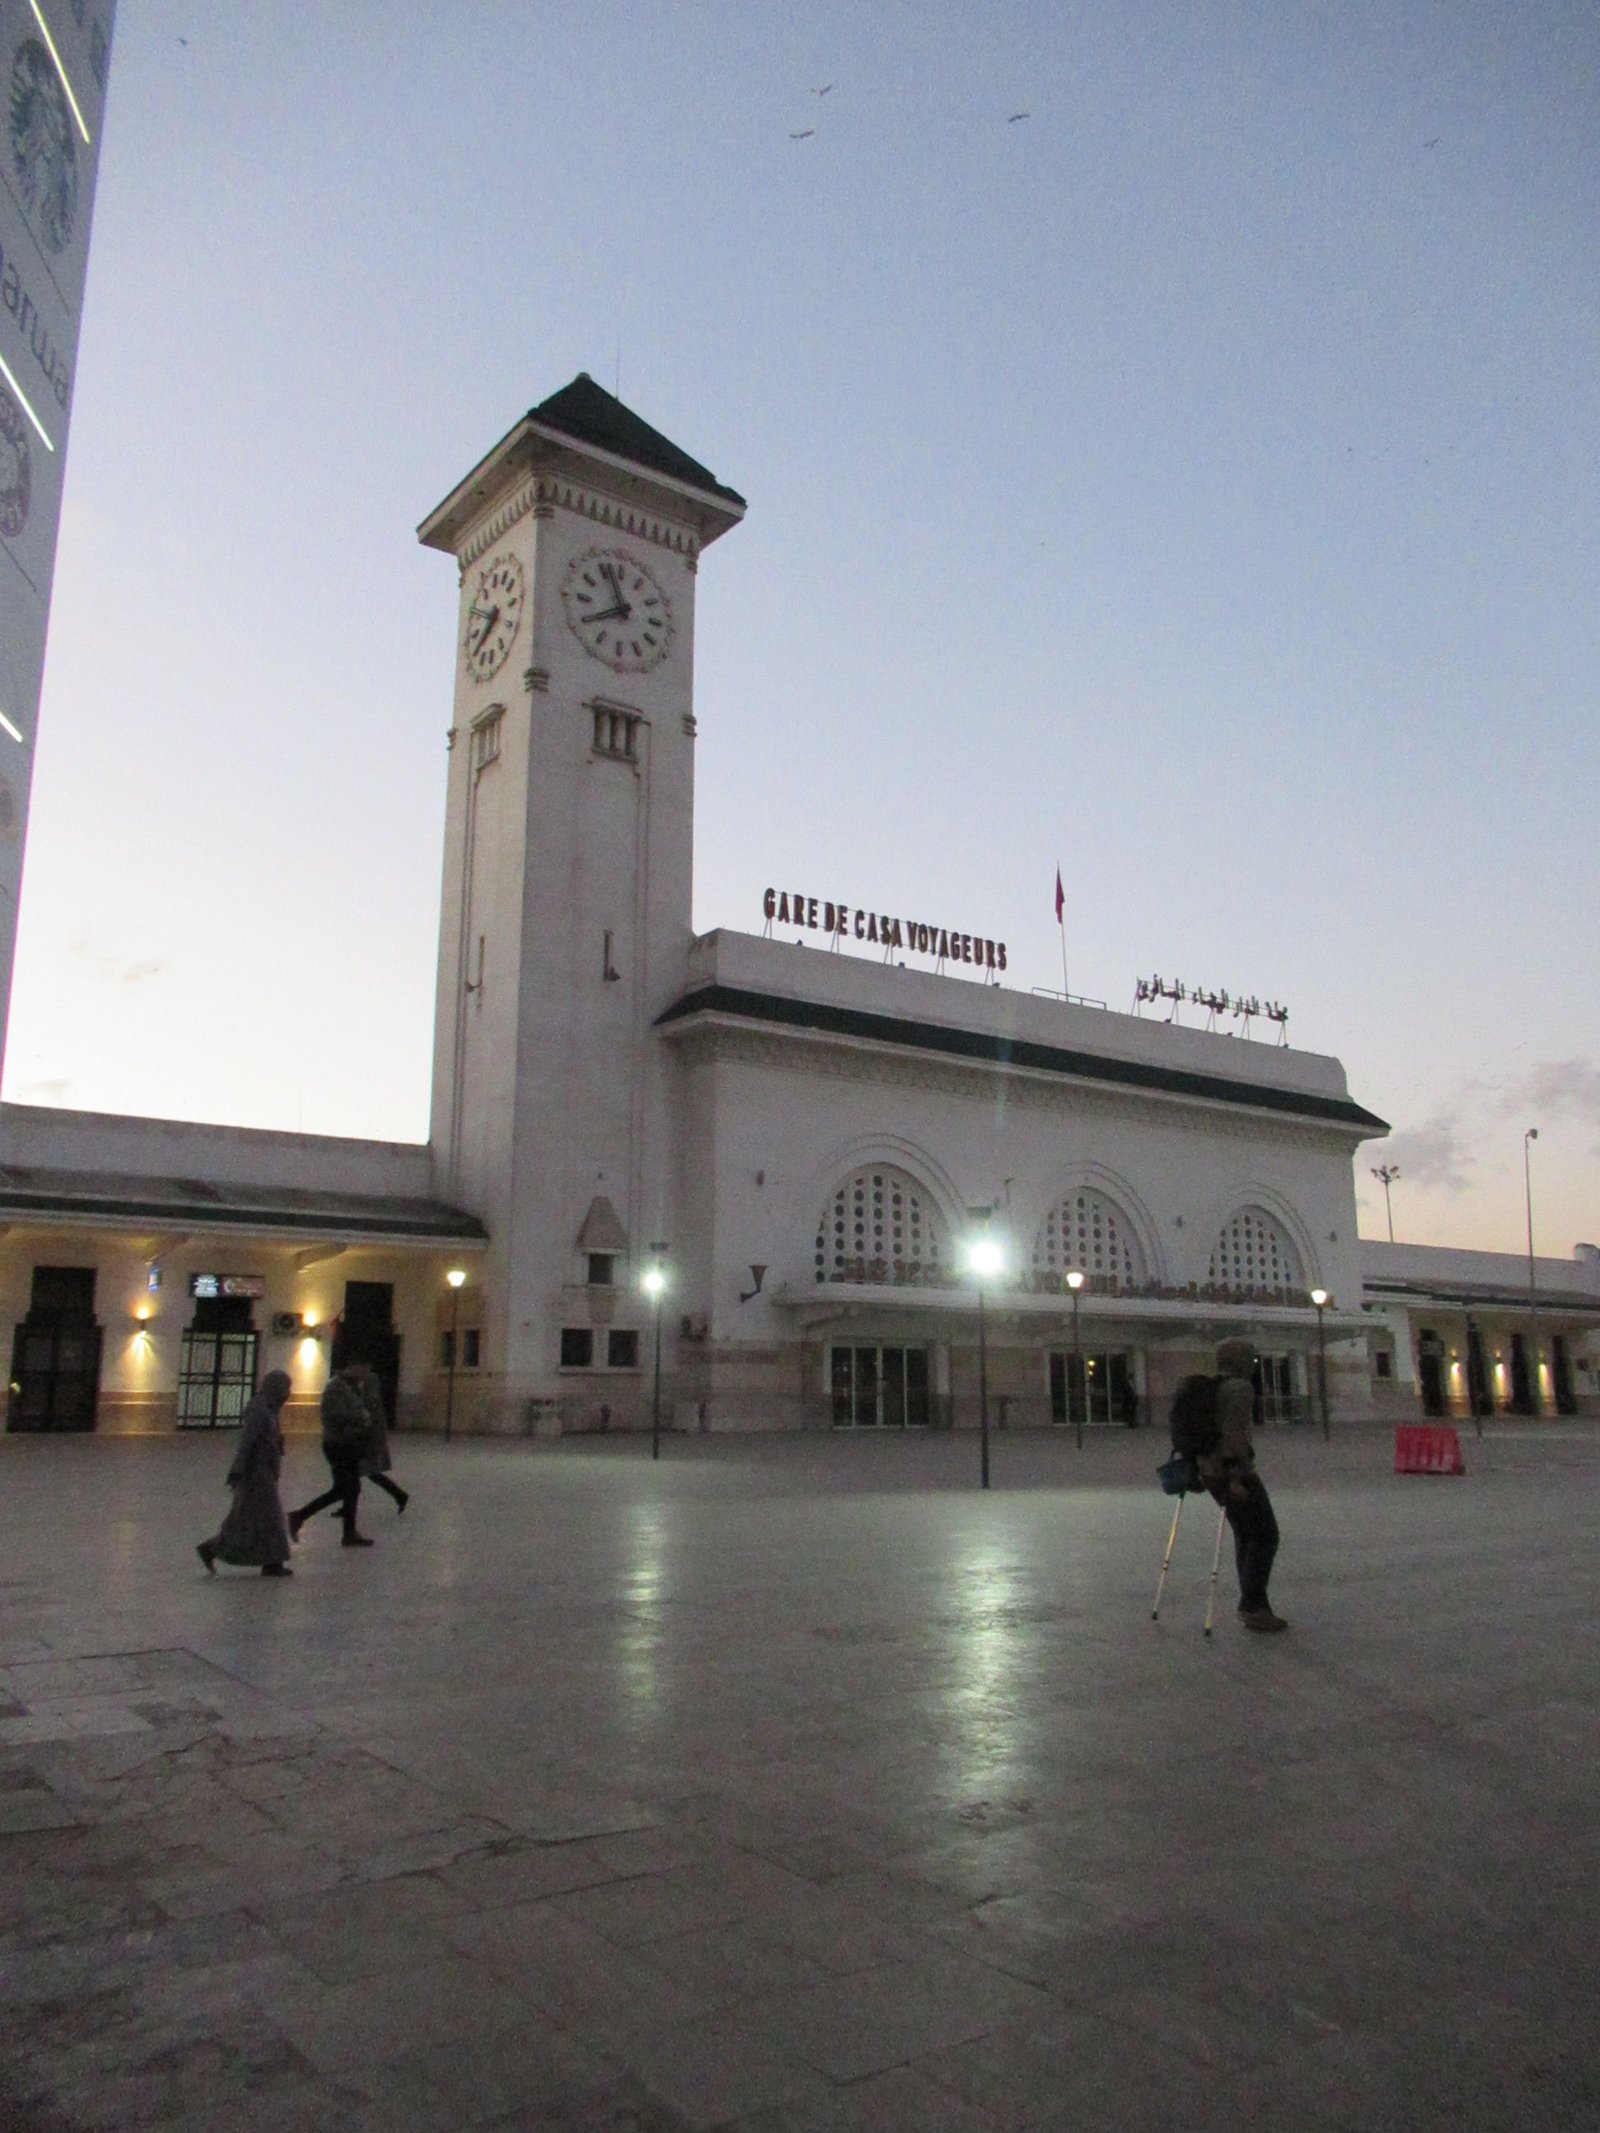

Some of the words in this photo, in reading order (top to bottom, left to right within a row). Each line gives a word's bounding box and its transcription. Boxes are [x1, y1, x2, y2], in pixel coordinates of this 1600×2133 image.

[764, 887, 818, 929] GARE
[824, 901, 848, 935] DE
[854, 909, 903, 948] CASA
[906, 920, 1007, 970] VOYAGEURS
